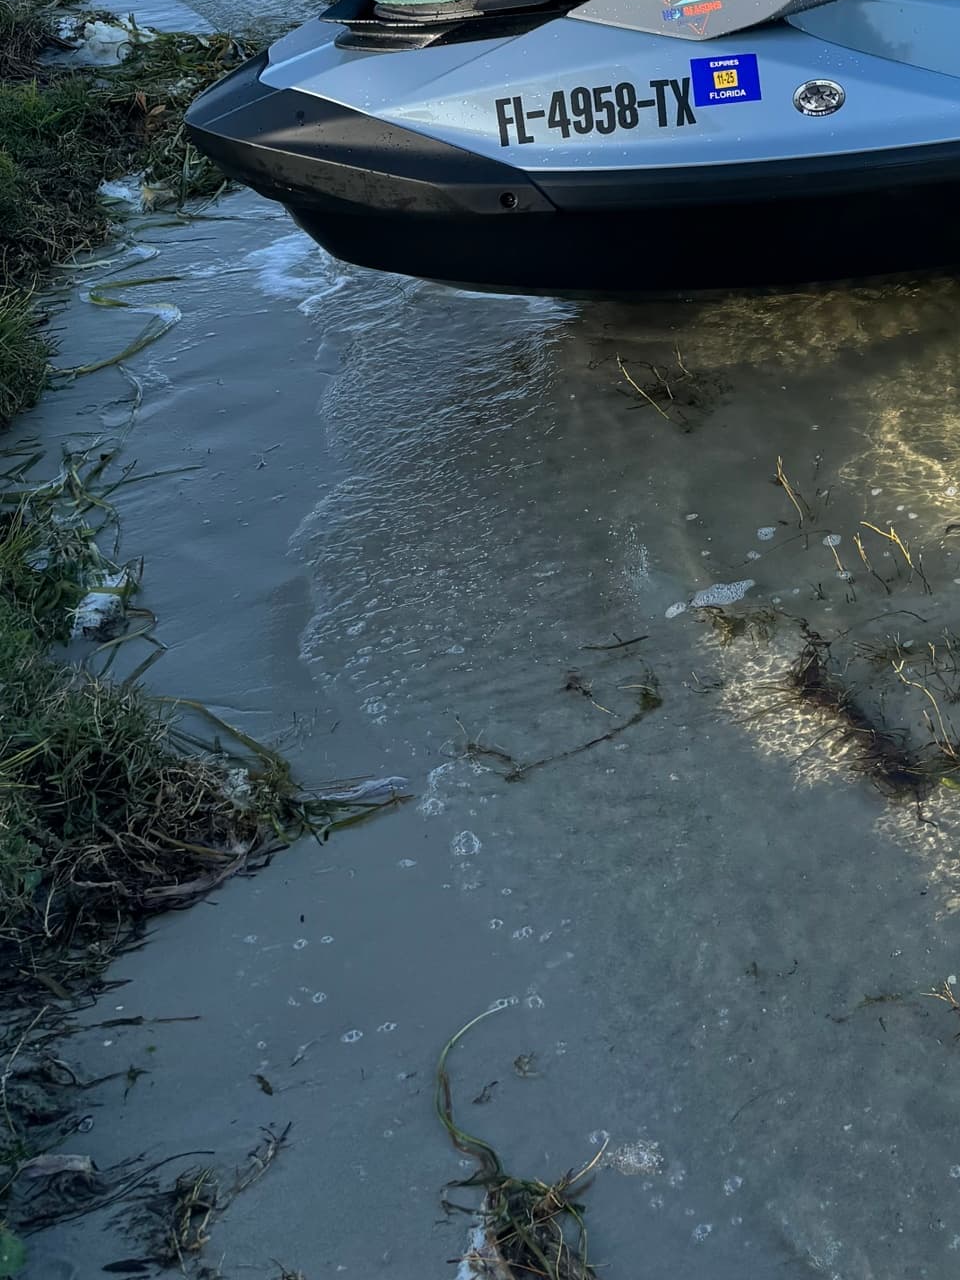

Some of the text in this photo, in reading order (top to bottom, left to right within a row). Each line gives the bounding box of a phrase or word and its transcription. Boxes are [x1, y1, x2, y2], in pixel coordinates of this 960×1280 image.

[709, 60, 739, 68] EXPIRES
[716, 72, 735, 85] 11-25
[709, 89, 746, 99] FLORIDA
[495, 77, 697, 147] FL-4958-TX
